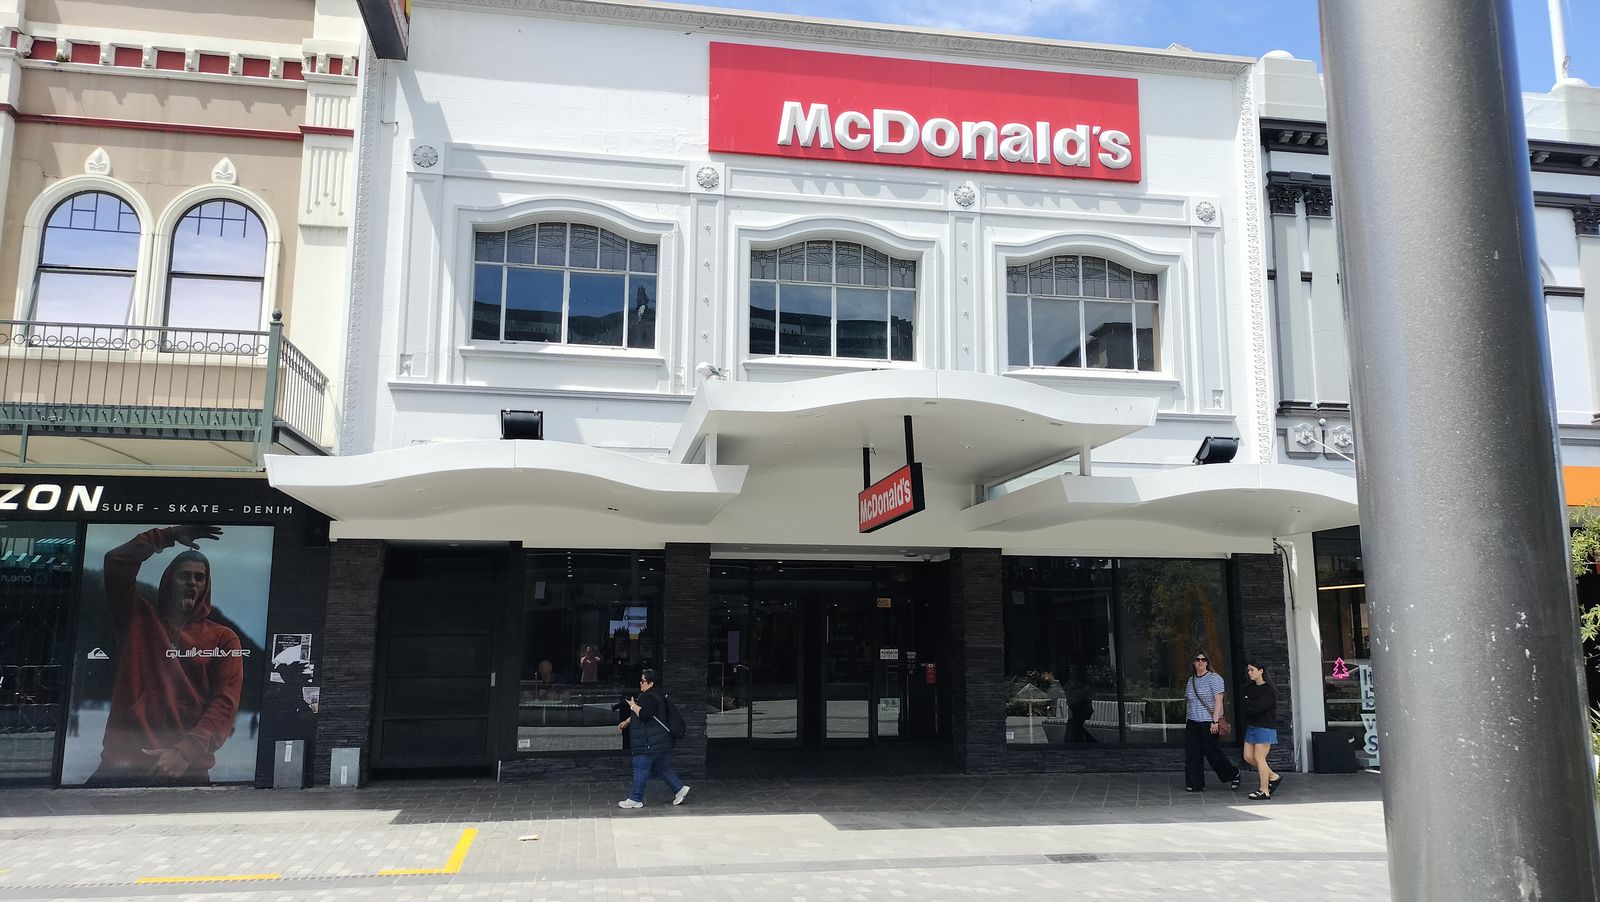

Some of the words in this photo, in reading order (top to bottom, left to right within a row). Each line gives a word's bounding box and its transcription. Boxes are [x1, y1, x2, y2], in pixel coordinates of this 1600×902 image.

[777, 100, 1132, 169] McDonald's
[101, 502, 145, 512] SURF
[168, 503, 220, 513] SKATE
[243, 505, 294, 515] DENIM
[860, 477, 911, 524] McDonald's
[165, 646, 252, 659] QUIKSILVER
